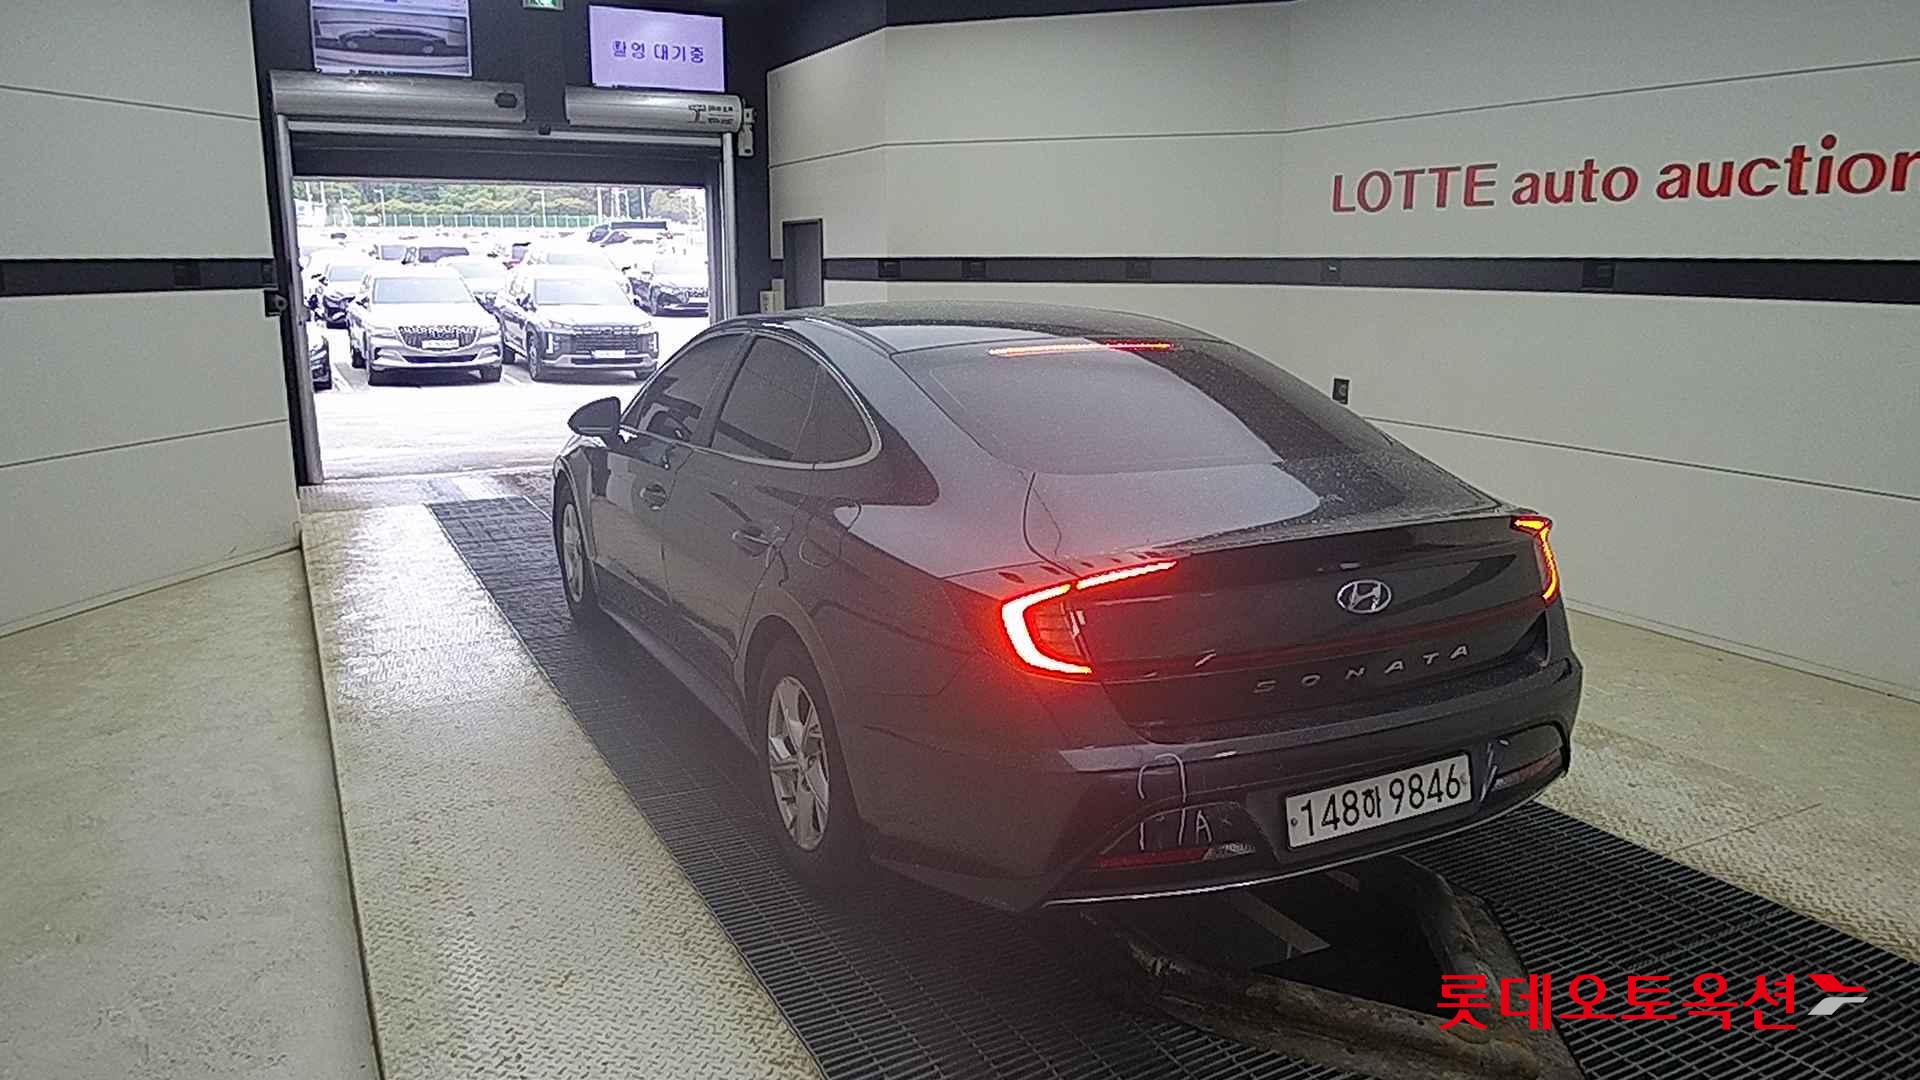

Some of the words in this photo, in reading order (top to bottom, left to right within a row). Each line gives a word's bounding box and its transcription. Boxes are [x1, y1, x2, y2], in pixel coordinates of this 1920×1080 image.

[653, 43, 704, 64] 대기중
[1331, 162, 1499, 213] LOTTE
[1510, 157, 1640, 206] auto
[1252, 644, 1469, 695] SONATA
[1300, 784, 1382, 837] 148하
[1388, 763, 1462, 816] 9846
